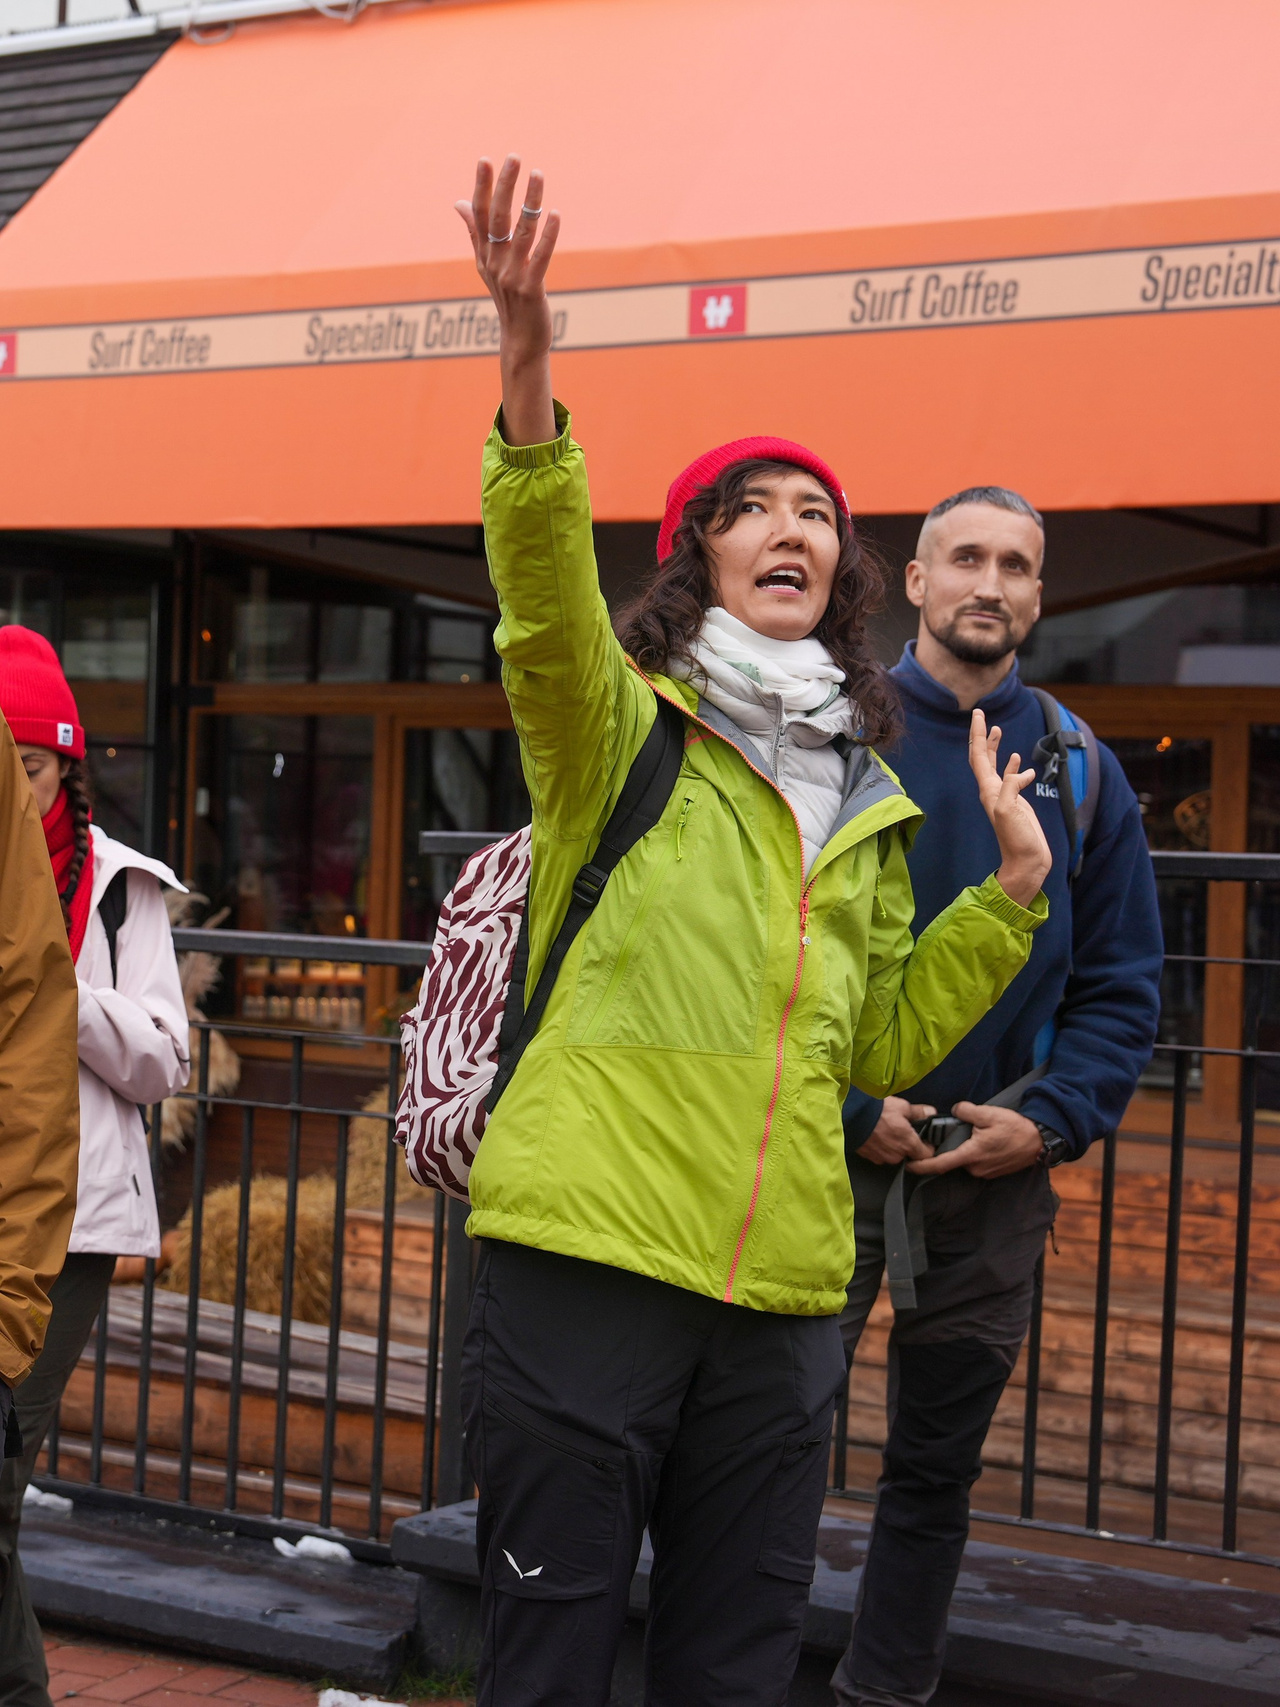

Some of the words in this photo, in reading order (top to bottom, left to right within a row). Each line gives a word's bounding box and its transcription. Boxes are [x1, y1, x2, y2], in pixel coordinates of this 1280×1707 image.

[849, 274, 915, 324] Surf
[919, 268, 1019, 320] Coffee
[1141, 246, 1280, 311] Specialt
[88, 328, 136, 370] Surf
[138, 323, 211, 367] Coffee
[304, 308, 418, 364] Specialty
